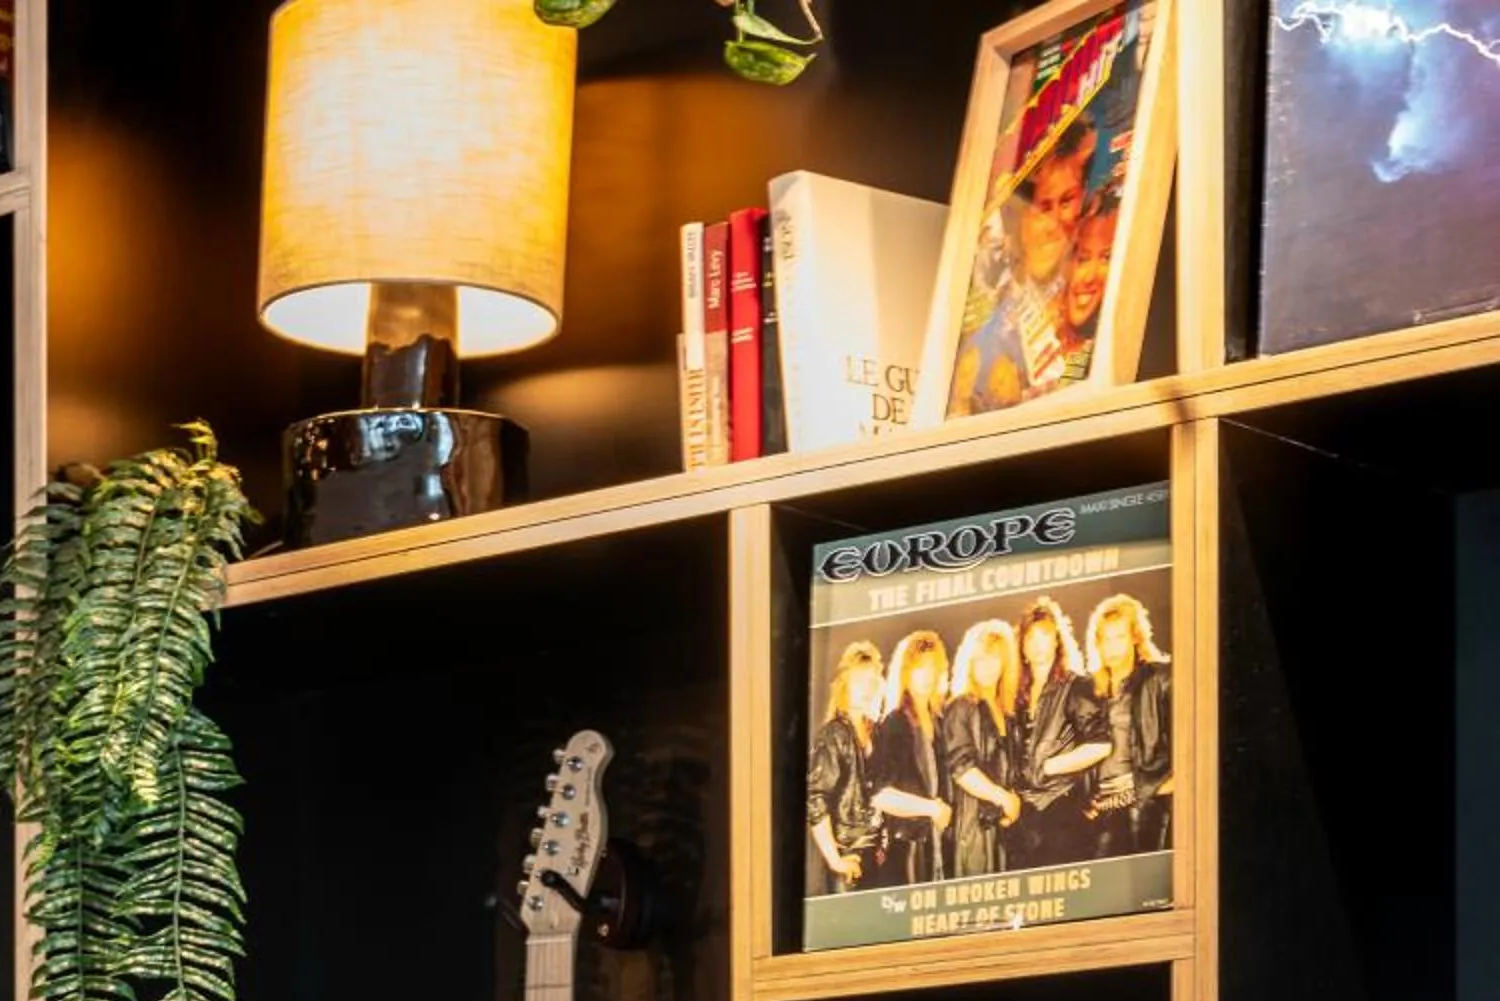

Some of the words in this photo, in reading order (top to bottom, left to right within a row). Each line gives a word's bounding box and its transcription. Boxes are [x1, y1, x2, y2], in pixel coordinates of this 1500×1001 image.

[709, 248, 726, 278] Levy
[706, 280, 724, 310] Marc
[846, 354, 879, 388] LE
[872, 393, 909, 425] DE
[821, 507, 1076, 583] EUROPE
[868, 586, 910, 612] THE
[916, 572, 977, 603] FINAL
[981, 546, 1120, 592] COUNTDOWN
[910, 889, 938, 911] ON
[945, 877, 1020, 907] BROKEN
[1028, 868, 1092, 895] WINGS
[911, 912, 971, 936] HEART
[975, 905, 1000, 929] OF
[1004, 897, 1066, 926] STONE
